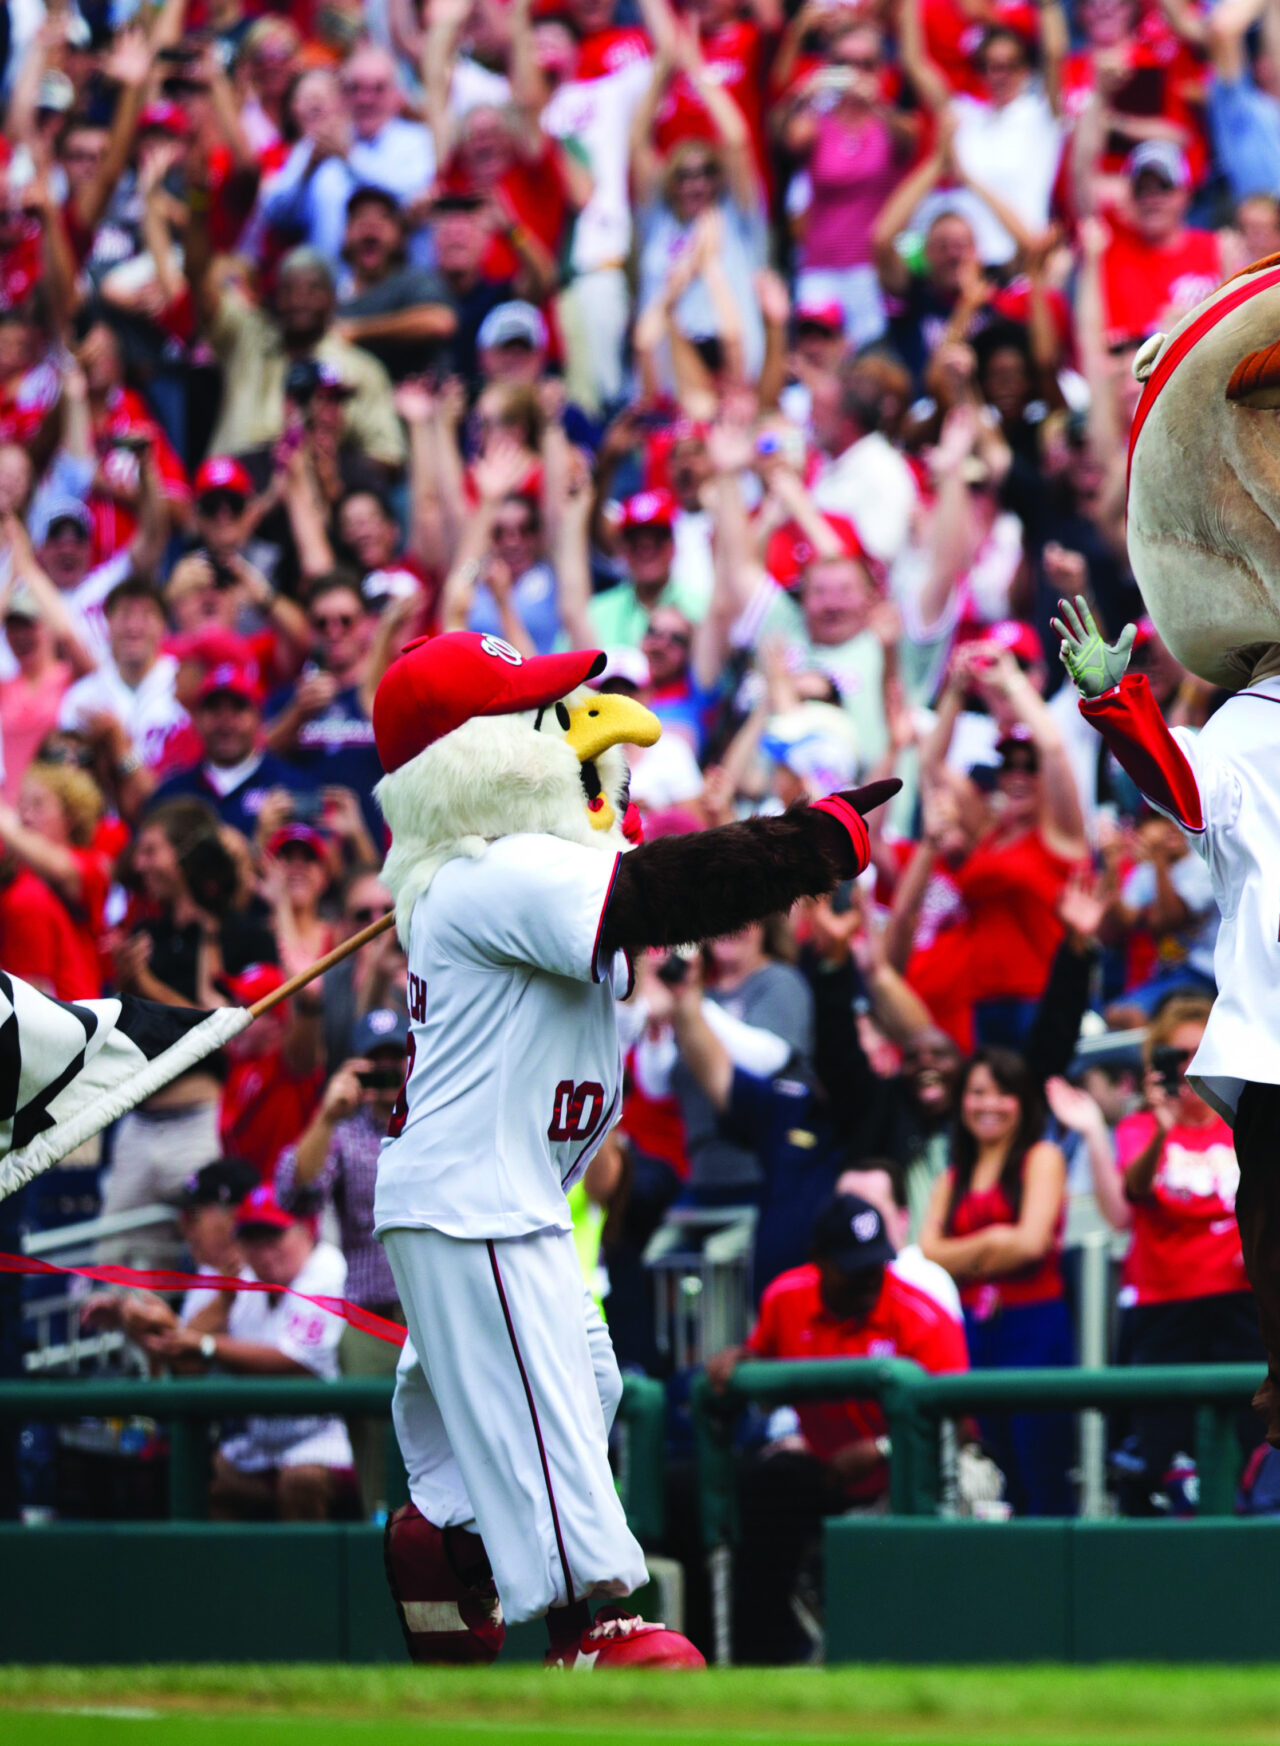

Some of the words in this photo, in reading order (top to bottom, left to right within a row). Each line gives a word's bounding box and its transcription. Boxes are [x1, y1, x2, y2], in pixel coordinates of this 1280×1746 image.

[481, 632, 522, 667] W
[407, 971, 427, 1024] CH
[547, 1080, 604, 1142] 00
